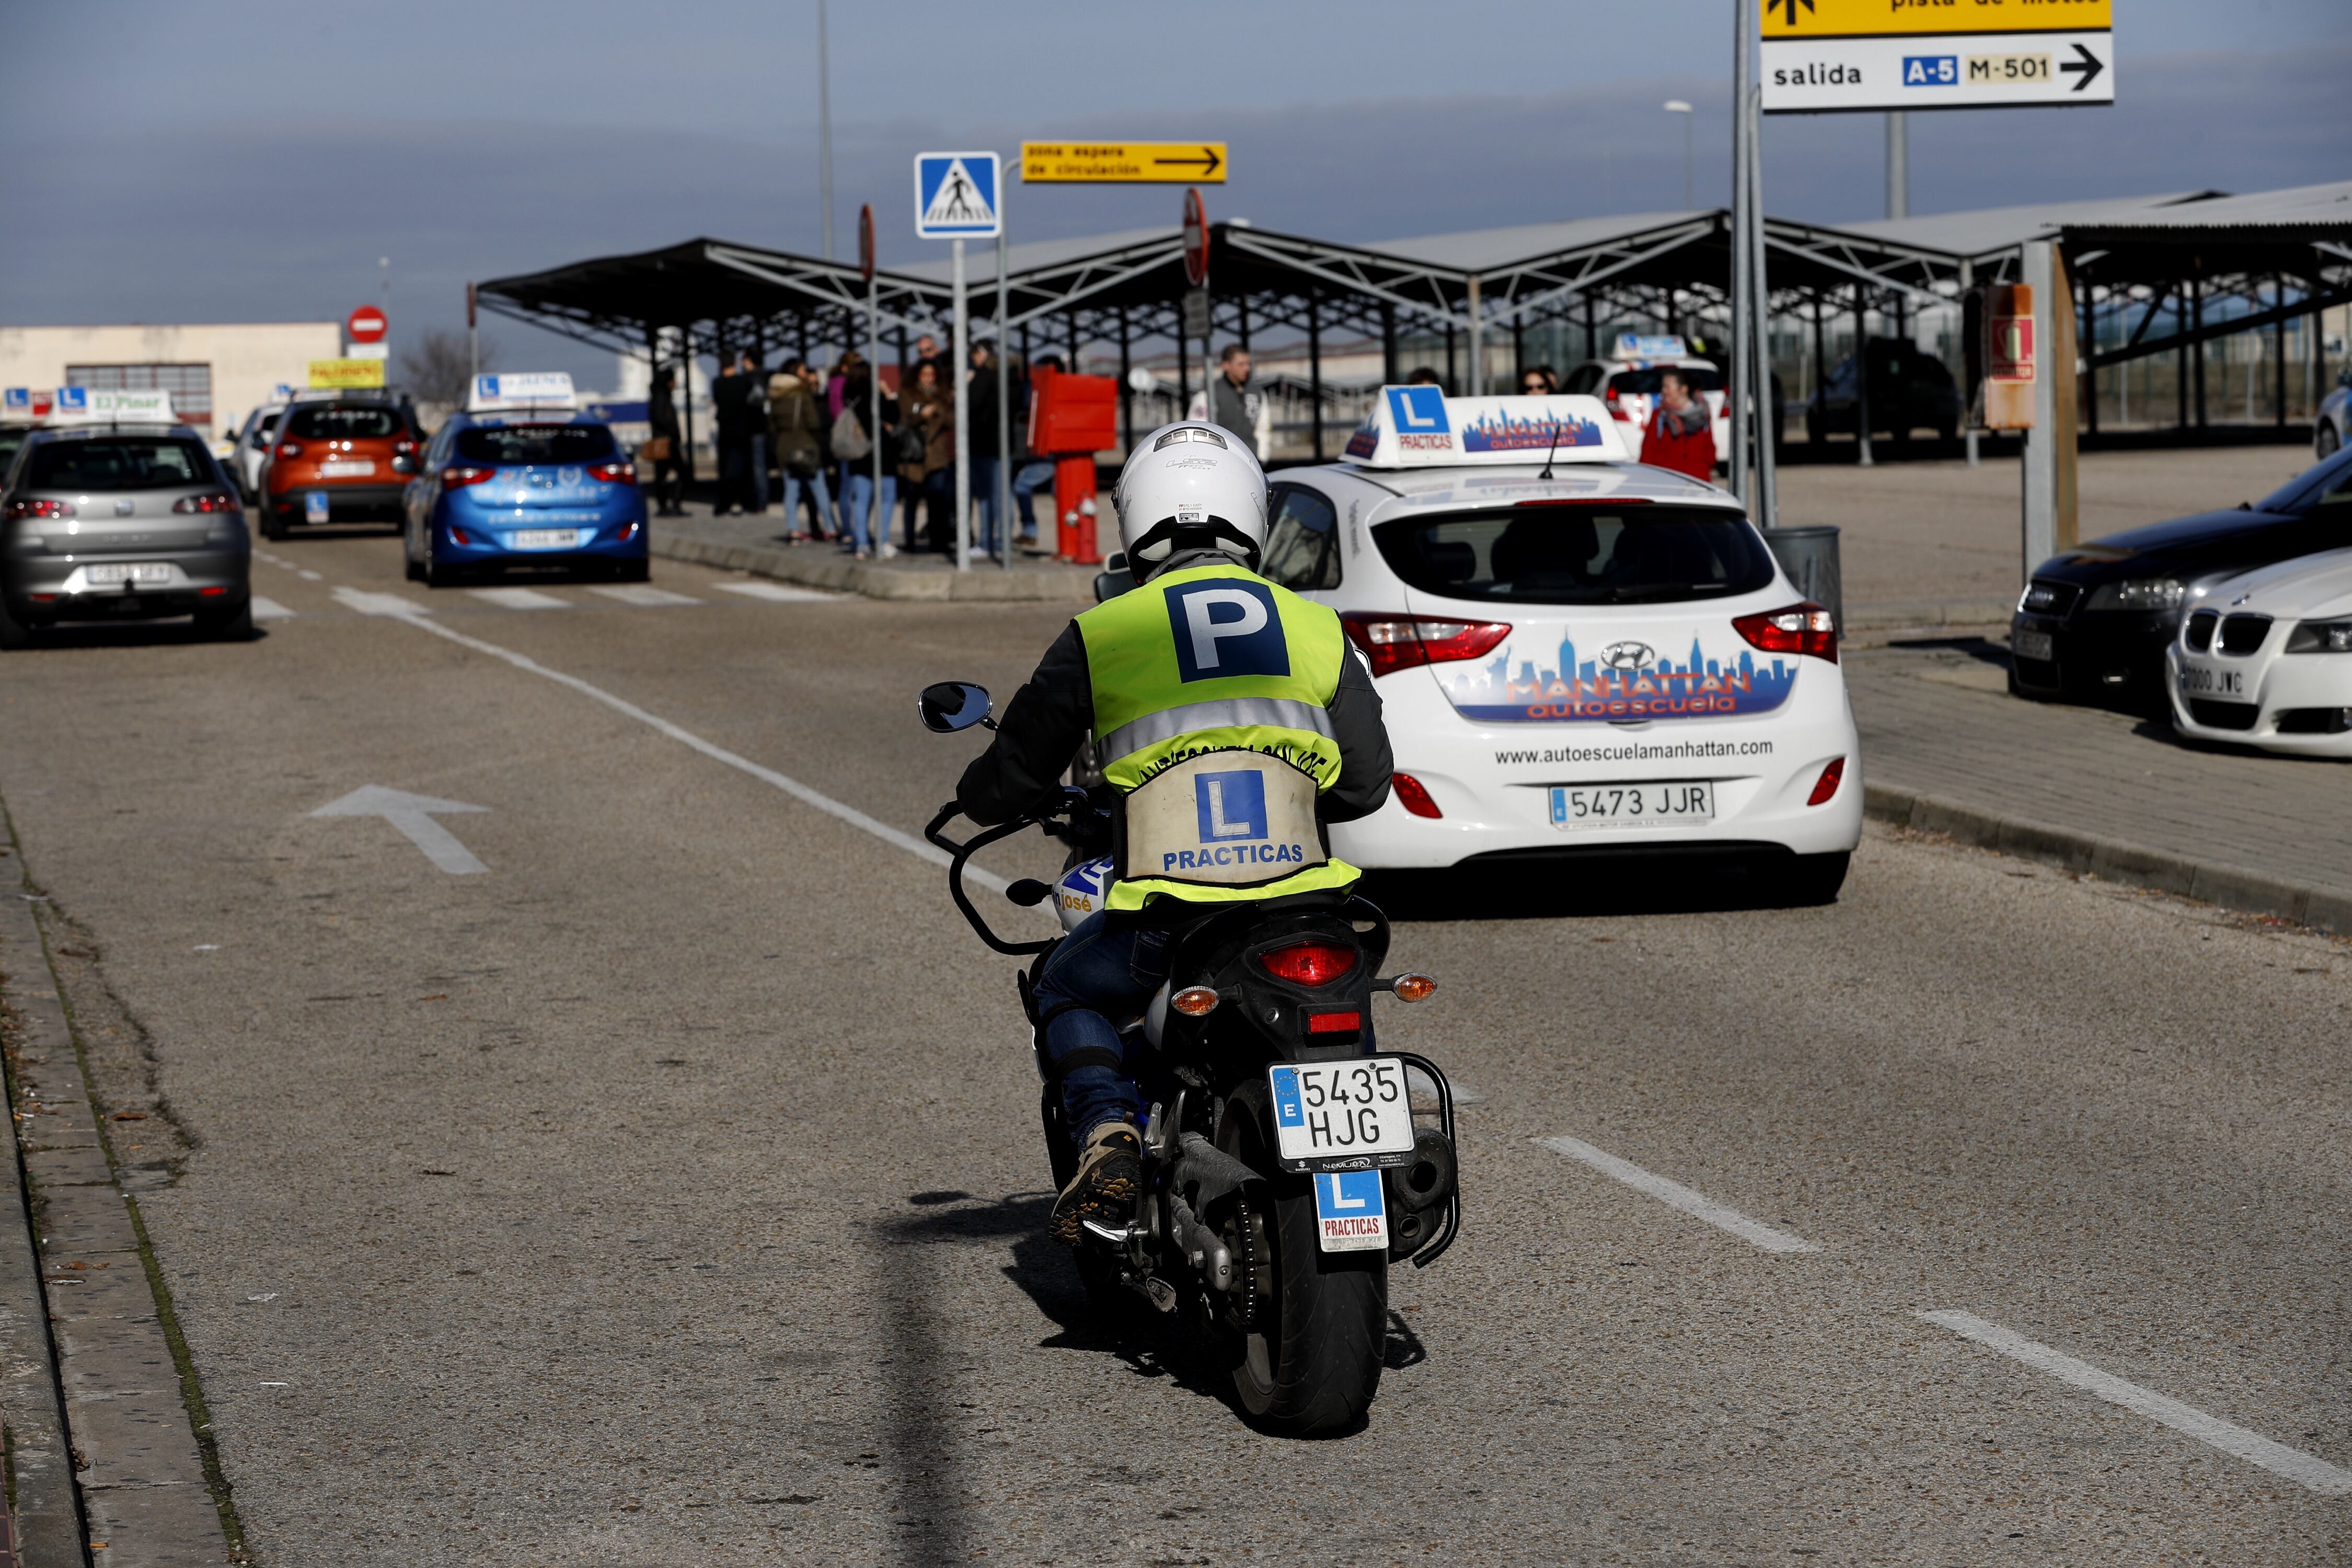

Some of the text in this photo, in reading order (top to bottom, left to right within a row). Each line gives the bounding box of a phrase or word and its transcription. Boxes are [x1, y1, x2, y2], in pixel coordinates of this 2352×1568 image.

[1774, 59, 2047, 85] salida A-5 M-501
[1029, 146, 1124, 160] zona espera
[1028, 163, 1045, 174] de
[63, 387, 81, 405] L
[1401, 393, 1435, 427] L
[1400, 434, 1452, 450] PRACTICAS
[1480, 421, 1581, 440] MANHATTAN
[1491, 435, 1576, 450] autoescuela
[1182, 589, 1267, 669] P
[1507, 672, 1751, 702] MANHATTAN
[1527, 696, 1735, 718] autoescuela
[1495, 741, 1773, 764] www.autoescuelamanhattan.com
[1207, 781, 1250, 837] L
[1572, 790, 1643, 817] 5473
[1656, 788, 1705, 813] JJR
[1163, 844, 1303, 871] PRACTICAS
[1302, 1066, 1398, 1106] 5435
[1284, 1104, 1296, 1116] E
[1309, 1109, 1380, 1147] HJG
[1331, 1173, 1366, 1209] L
[1325, 1218, 1379, 1236] PRACTICAS
